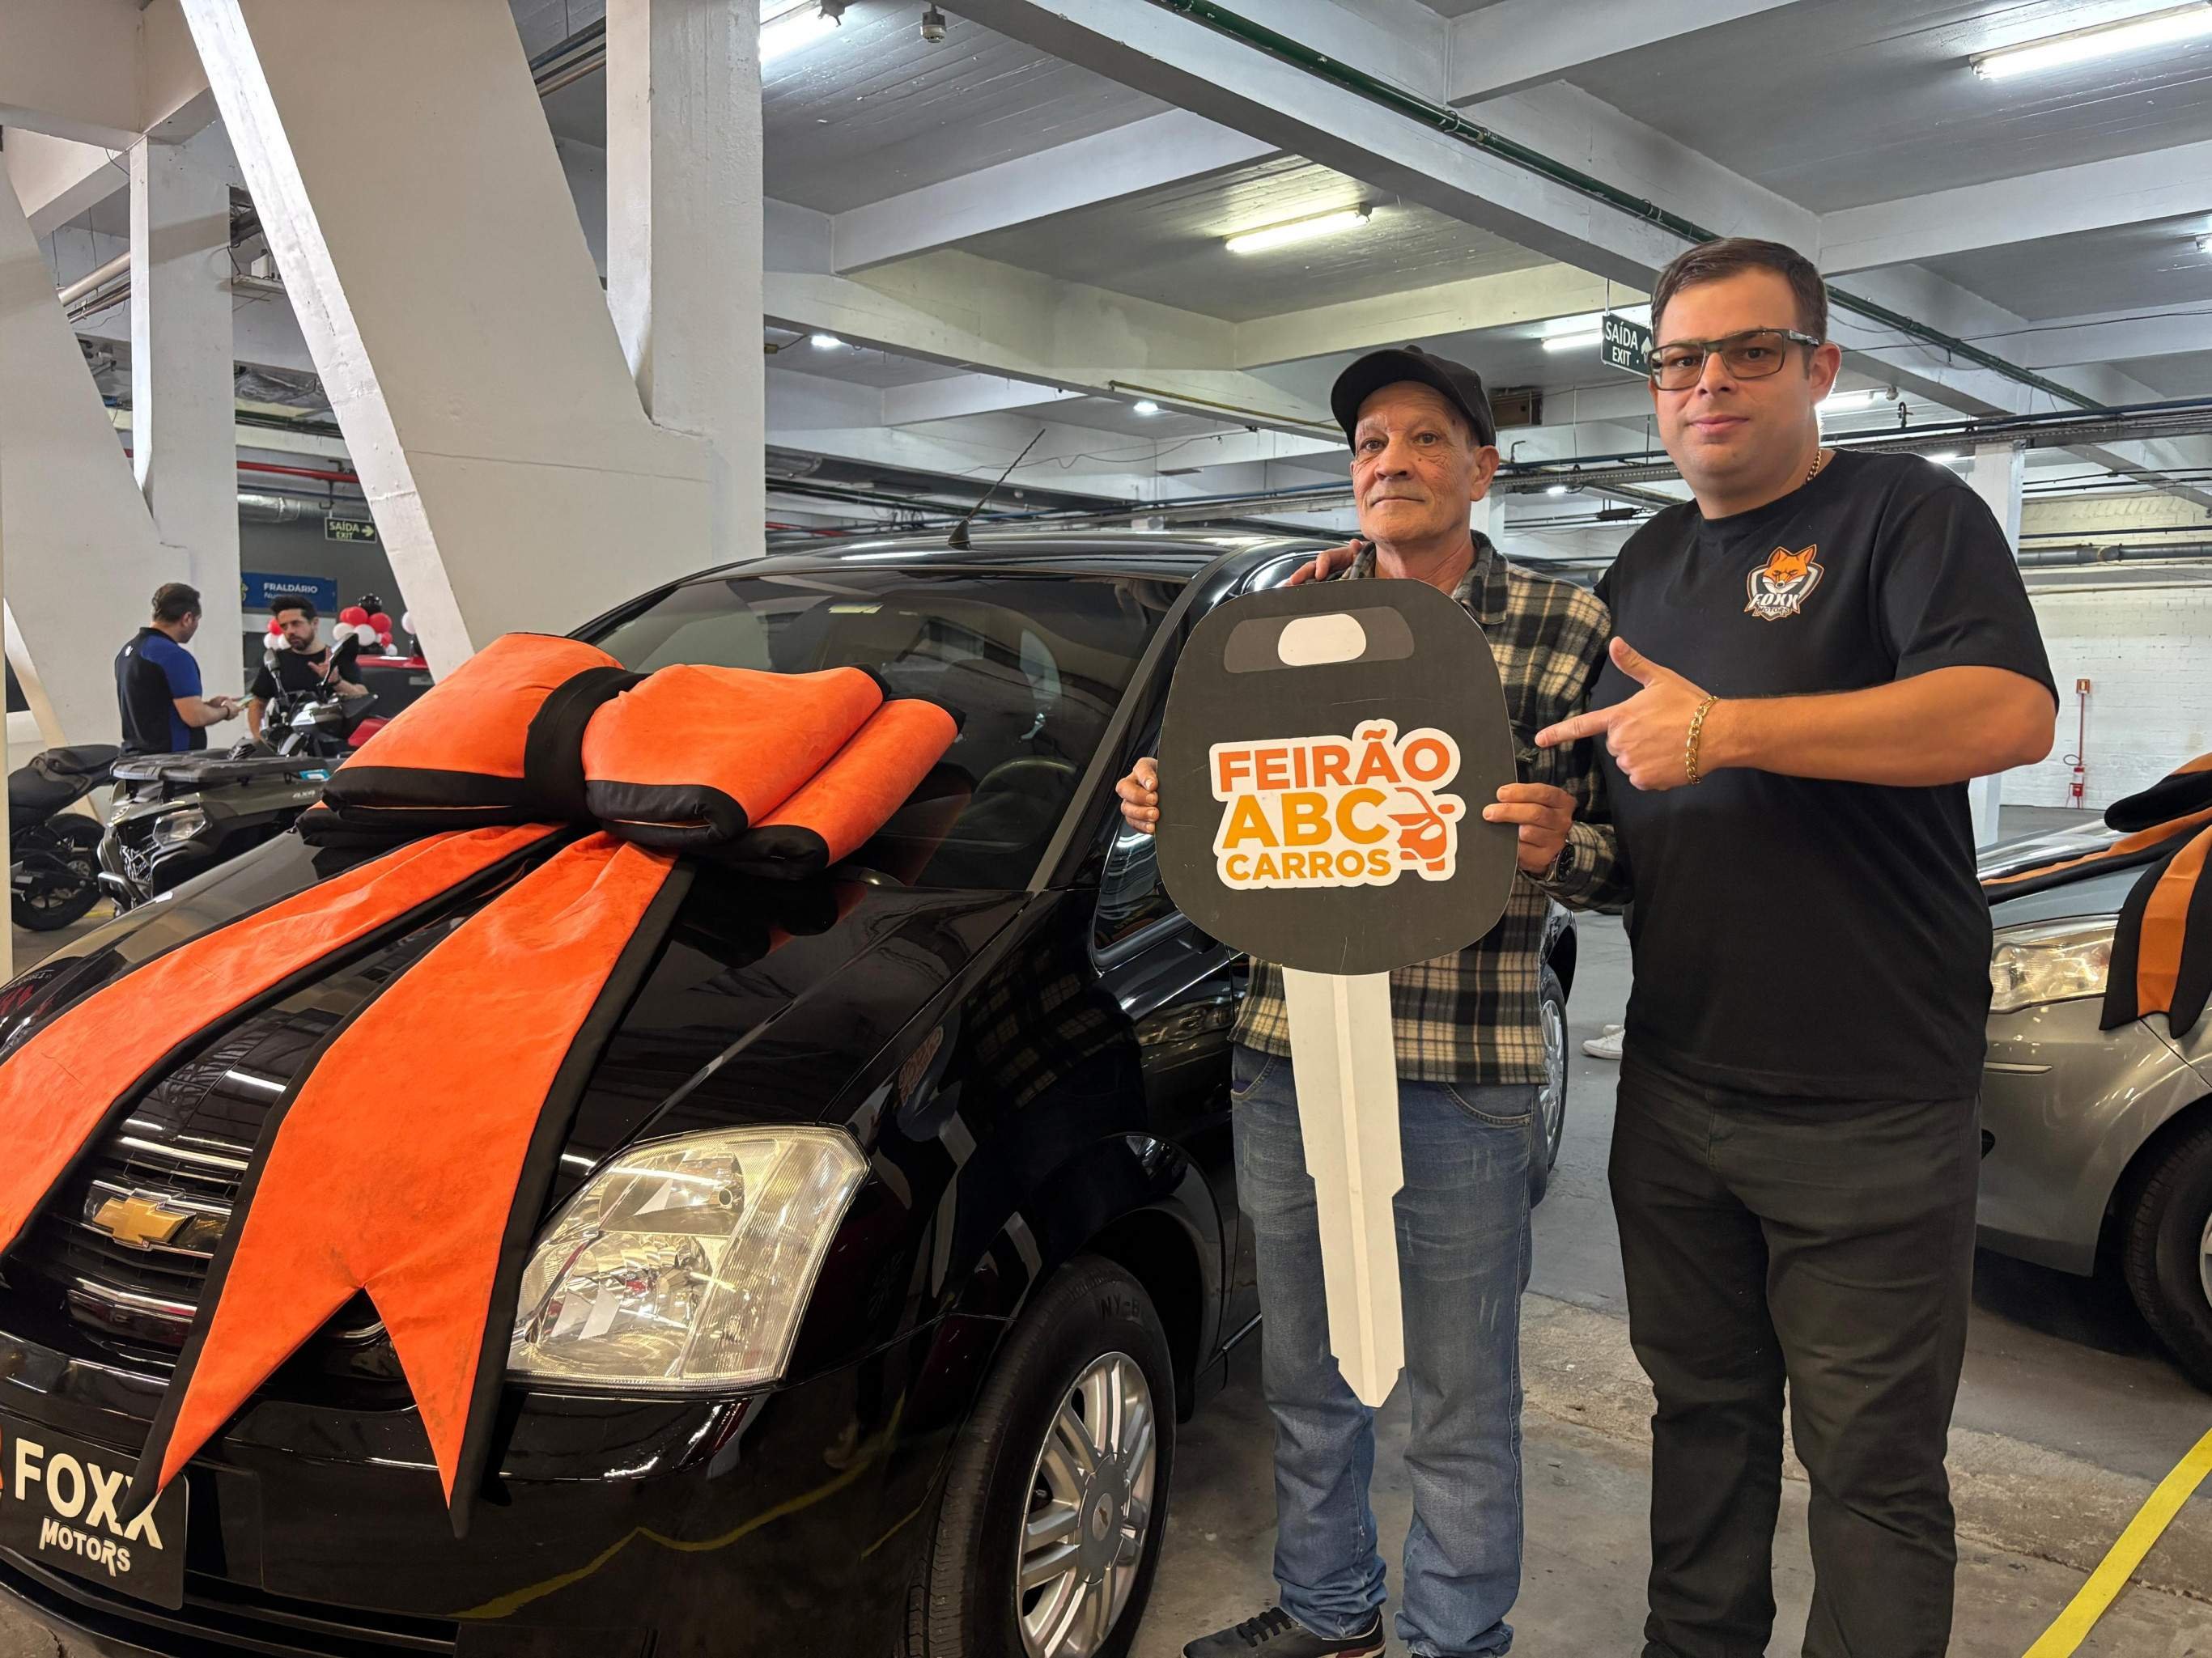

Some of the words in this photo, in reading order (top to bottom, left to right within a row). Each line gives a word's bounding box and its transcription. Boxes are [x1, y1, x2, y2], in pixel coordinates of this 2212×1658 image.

[1605, 320, 1639, 351] SAÍDA
[1612, 346, 1632, 367] EXIT
[329, 521, 360, 533] SAÍDA
[336, 531, 354, 541] EXIT
[264, 583, 318, 594] FRALDÁRIO
[1747, 593, 1799, 612] FOXX
[1218, 728, 1450, 793] FEIRÃO
[1221, 787, 1390, 850] ABC
[1225, 848, 1392, 881] CARROS
[39, 1516, 131, 1577] MOTORS
